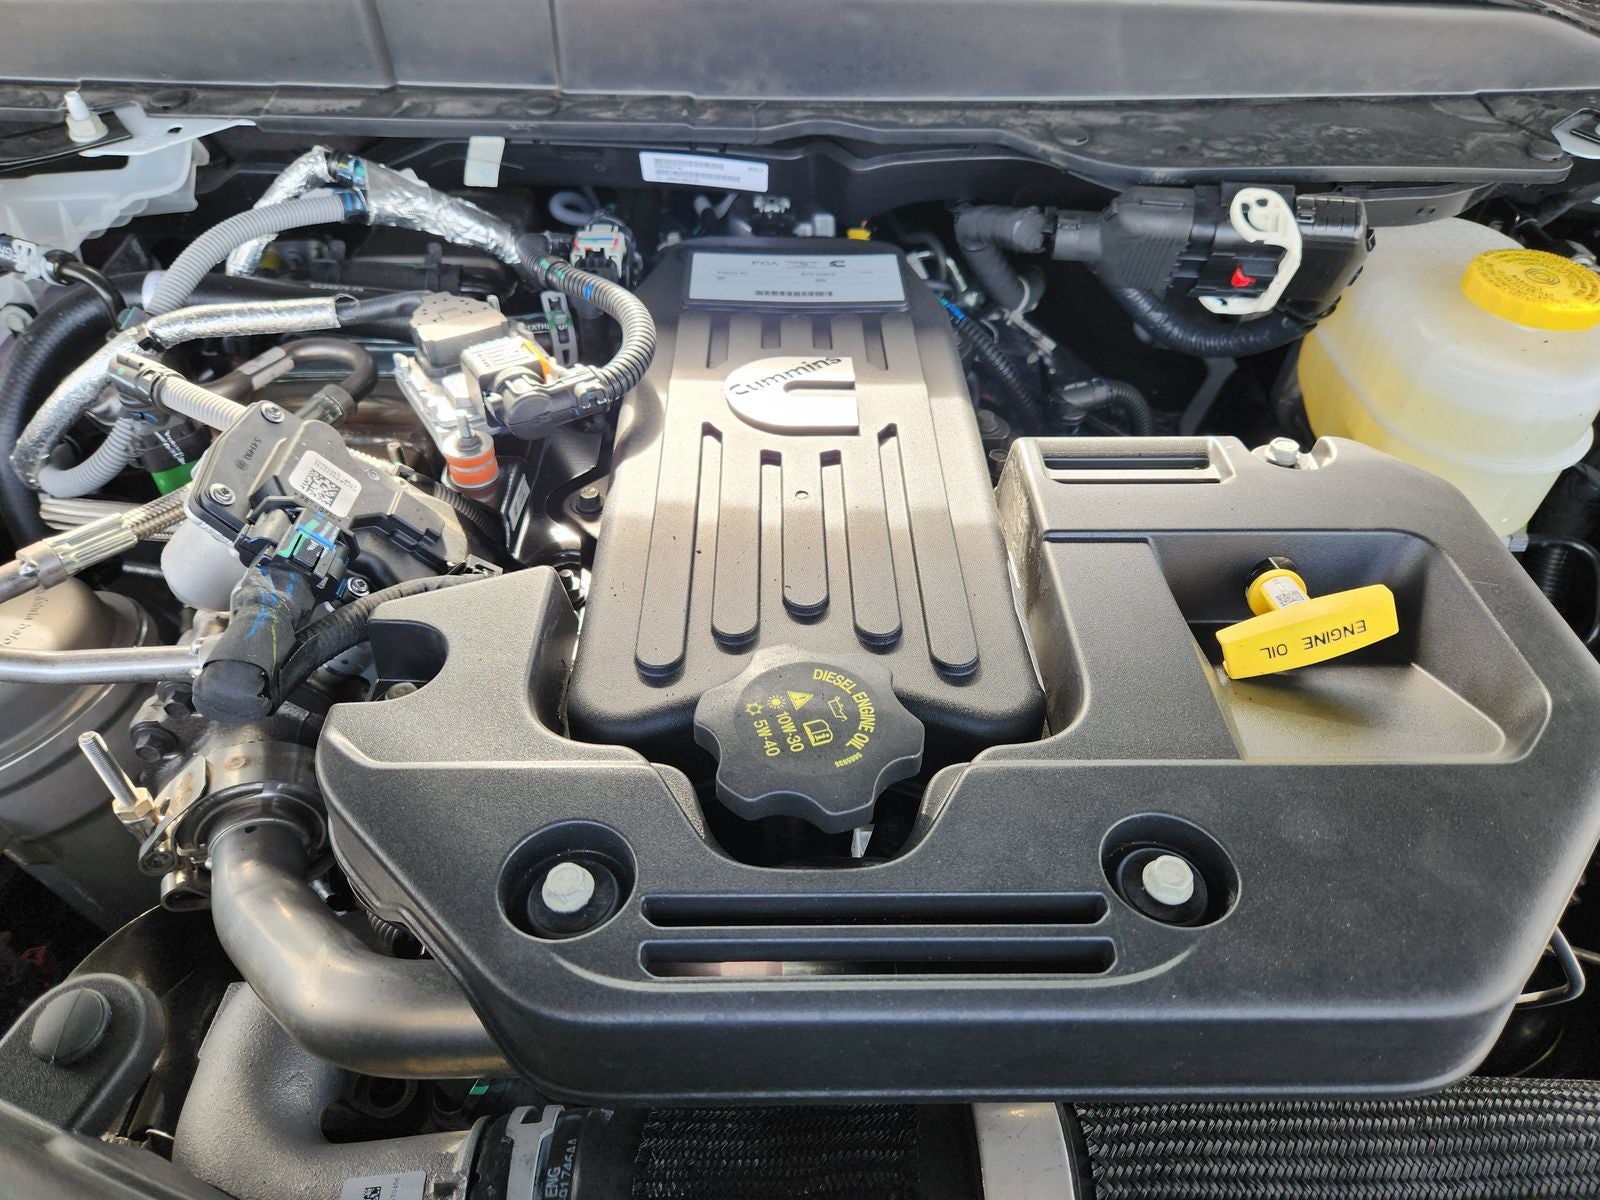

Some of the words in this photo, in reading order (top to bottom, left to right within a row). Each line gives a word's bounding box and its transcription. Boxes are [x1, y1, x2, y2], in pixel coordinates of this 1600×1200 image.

[729, 356, 843, 395] Cummins
[1260, 643, 1288, 659] OIL
[1301, 619, 1367, 651] ENGINE
[812, 668, 857, 695] DIESEL
[851, 691, 876, 733] ENGINE
[753, 719, 781, 757] 5W-40
[776, 711, 805, 752] 10W-30
[845, 733, 870, 750] OIL
[544, 1166, 561, 1197] ENG
[558, 1138, 577, 1200] 91746AA
